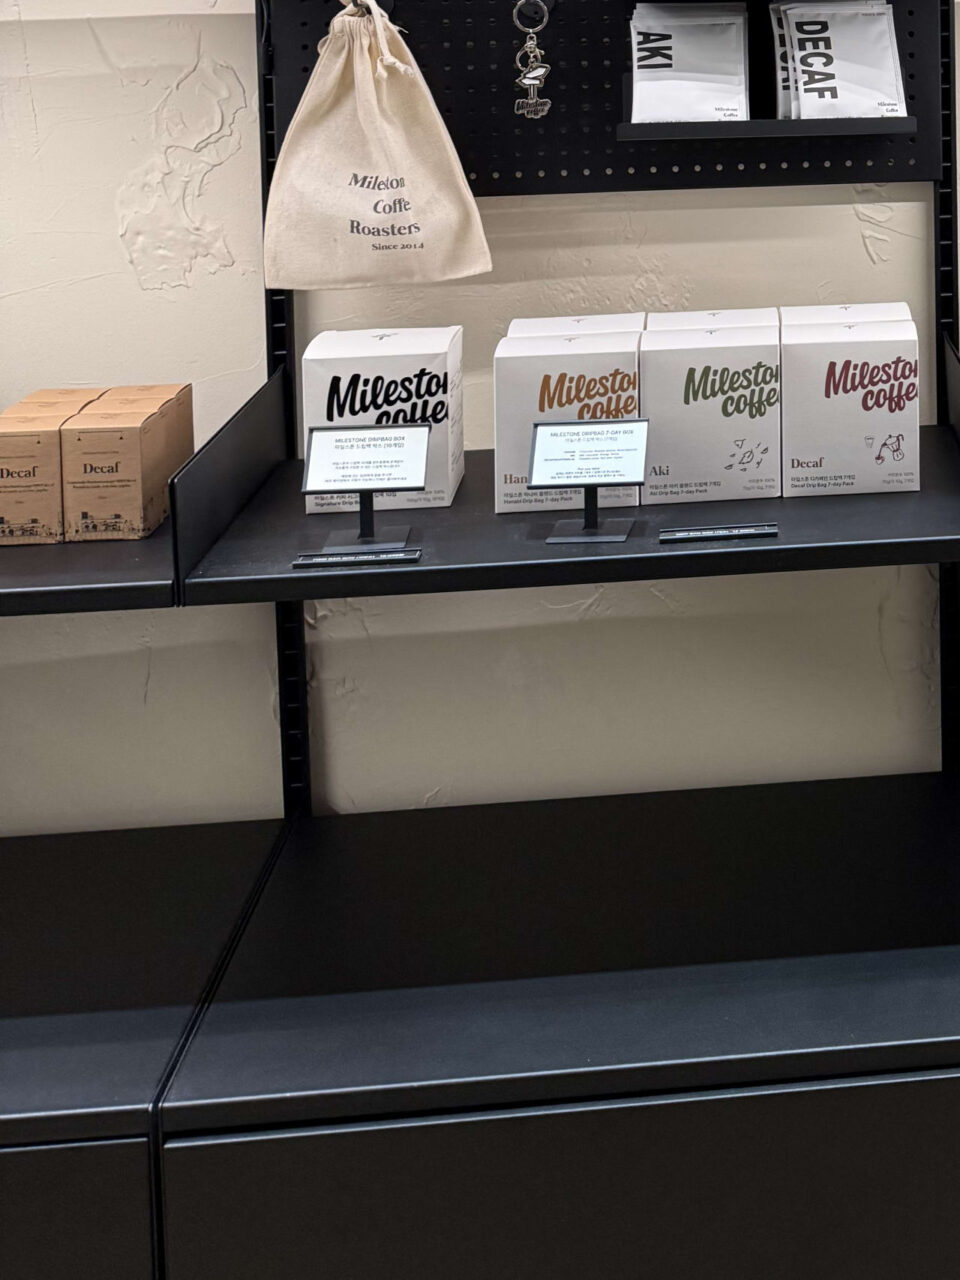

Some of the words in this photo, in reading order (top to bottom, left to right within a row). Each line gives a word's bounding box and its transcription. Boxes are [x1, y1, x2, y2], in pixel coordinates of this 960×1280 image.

[636, 31, 673, 70] AKI
[795, 21, 839, 99] DECAF
[349, 219, 421, 237] Roasters
[372, 243, 399, 251] Since
[401, 242, 424, 250] 2014
[722, 386, 779, 419] coffe
[862, 381, 918, 413] coffe
[577, 394, 637, 420] coffe
[83, 461, 121, 474] Decaf
[649, 465, 669, 476] Aki
[791, 457, 825, 469] Decaf
[0, 465, 39, 478] Decaf
[504, 474, 528, 484] Han
